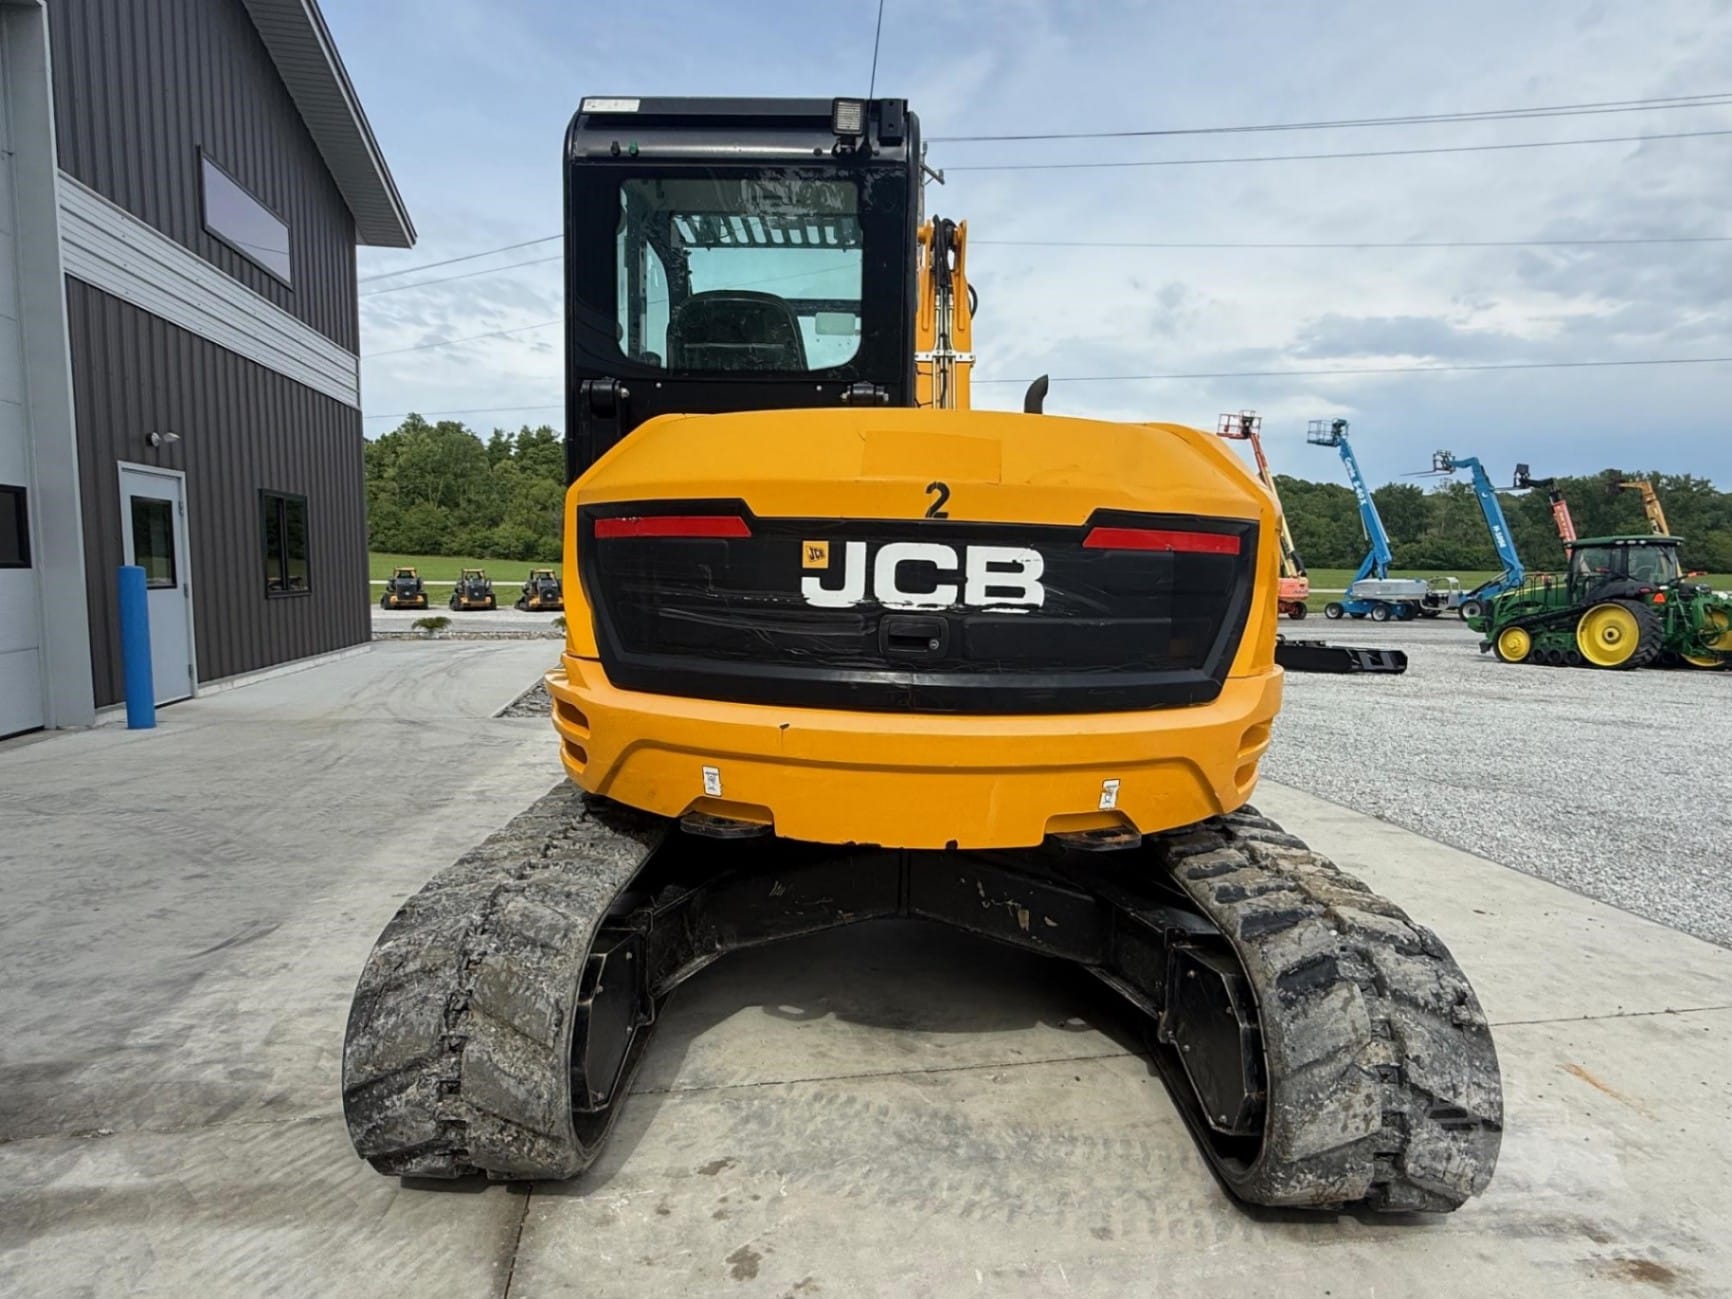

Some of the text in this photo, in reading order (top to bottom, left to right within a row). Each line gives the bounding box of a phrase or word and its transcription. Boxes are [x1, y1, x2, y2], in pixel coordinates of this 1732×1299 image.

[925, 481, 951, 519] 2
[808, 545, 826, 562] JCB
[801, 541, 1045, 614] JCB
